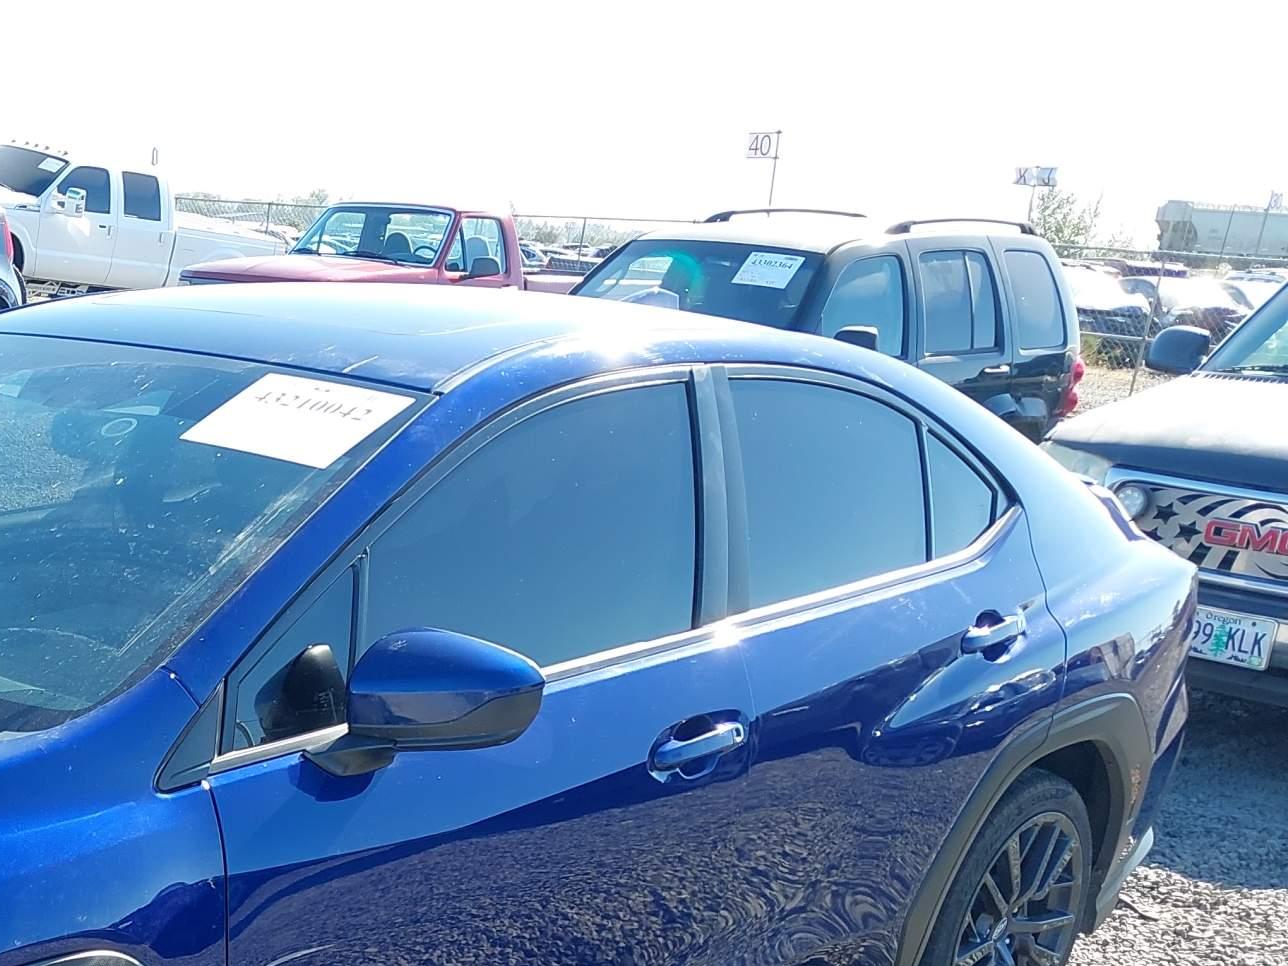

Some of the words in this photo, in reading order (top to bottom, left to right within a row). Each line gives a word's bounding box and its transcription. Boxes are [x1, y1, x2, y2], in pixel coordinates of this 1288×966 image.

[748, 134, 772, 156] 40
[1042, 168, 1053, 185] J
[1203, 518, 1288, 556] GM
[1205, 612, 1242, 625] Oregon
[1225, 626, 1267, 657] KLK
